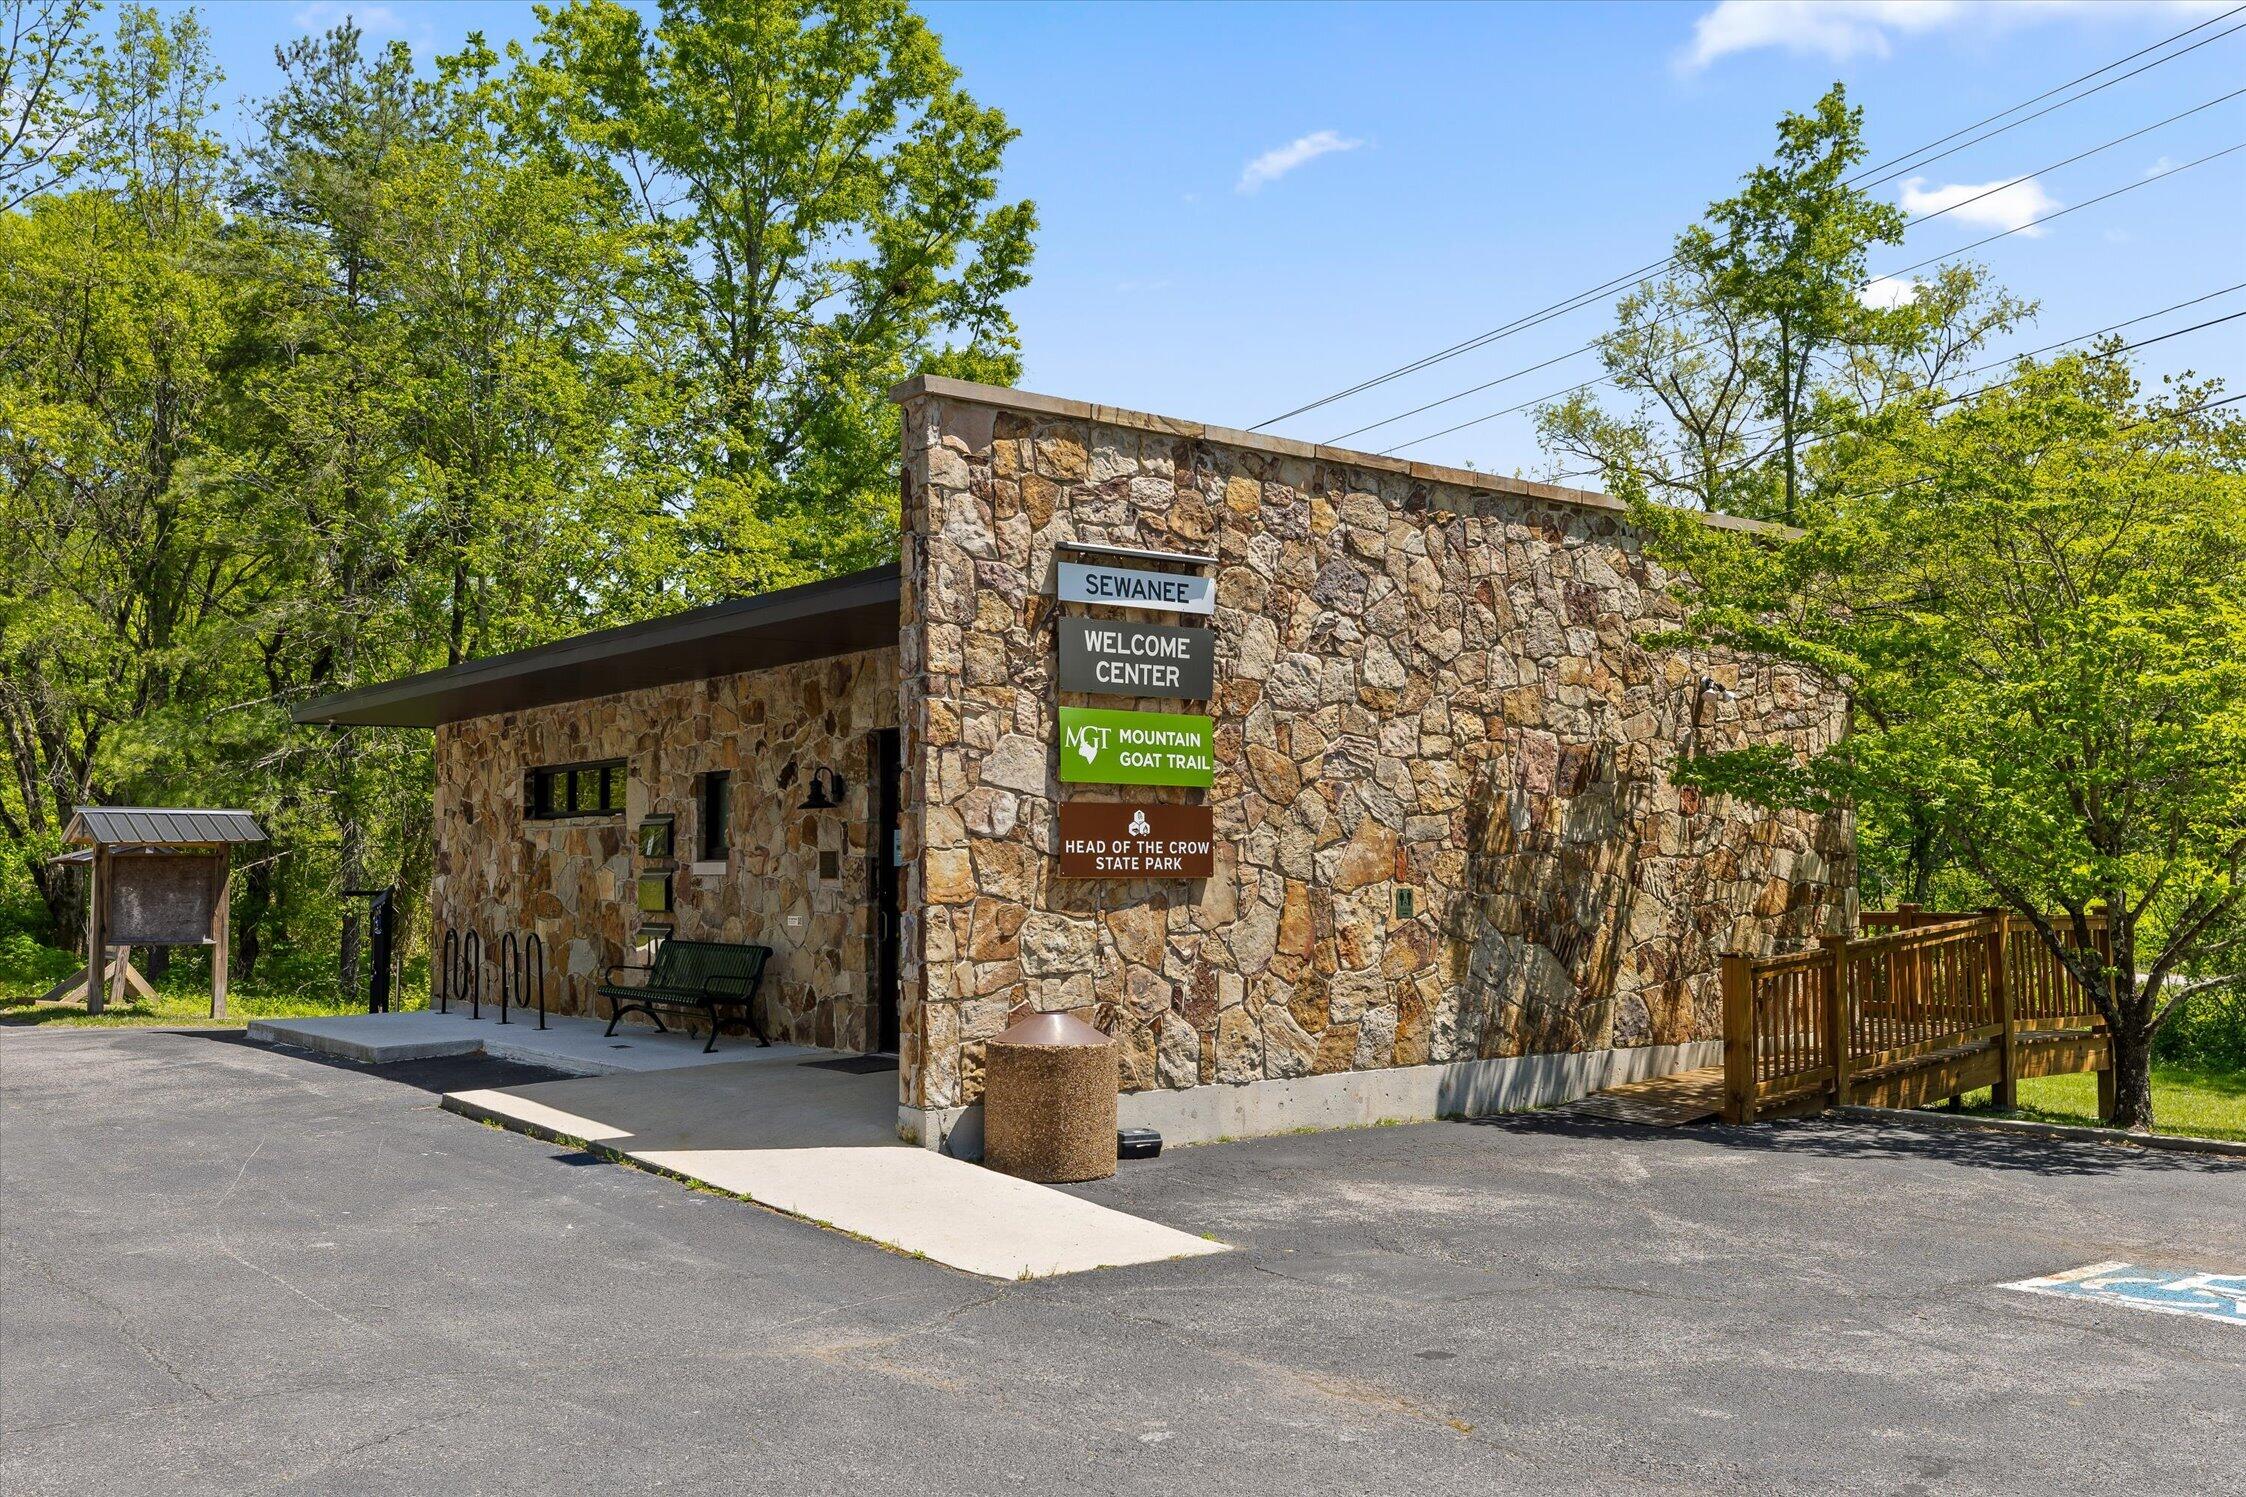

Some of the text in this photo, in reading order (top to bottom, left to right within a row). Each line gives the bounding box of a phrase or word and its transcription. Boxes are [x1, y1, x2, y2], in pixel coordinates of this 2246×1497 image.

[1085, 573, 1190, 604] SEWANEE
[1084, 629, 1191, 659] WELCOME
[1095, 660, 1180, 688] CENTER
[1064, 725, 1112, 751] MGT
[1119, 728, 1201, 748] MOUNTAIN
[1119, 751, 1211, 770] GOAT TRAIL
[1065, 840, 1210, 855] HEAD OF THE CROW
[1095, 856, 1183, 871] STATE PARK
